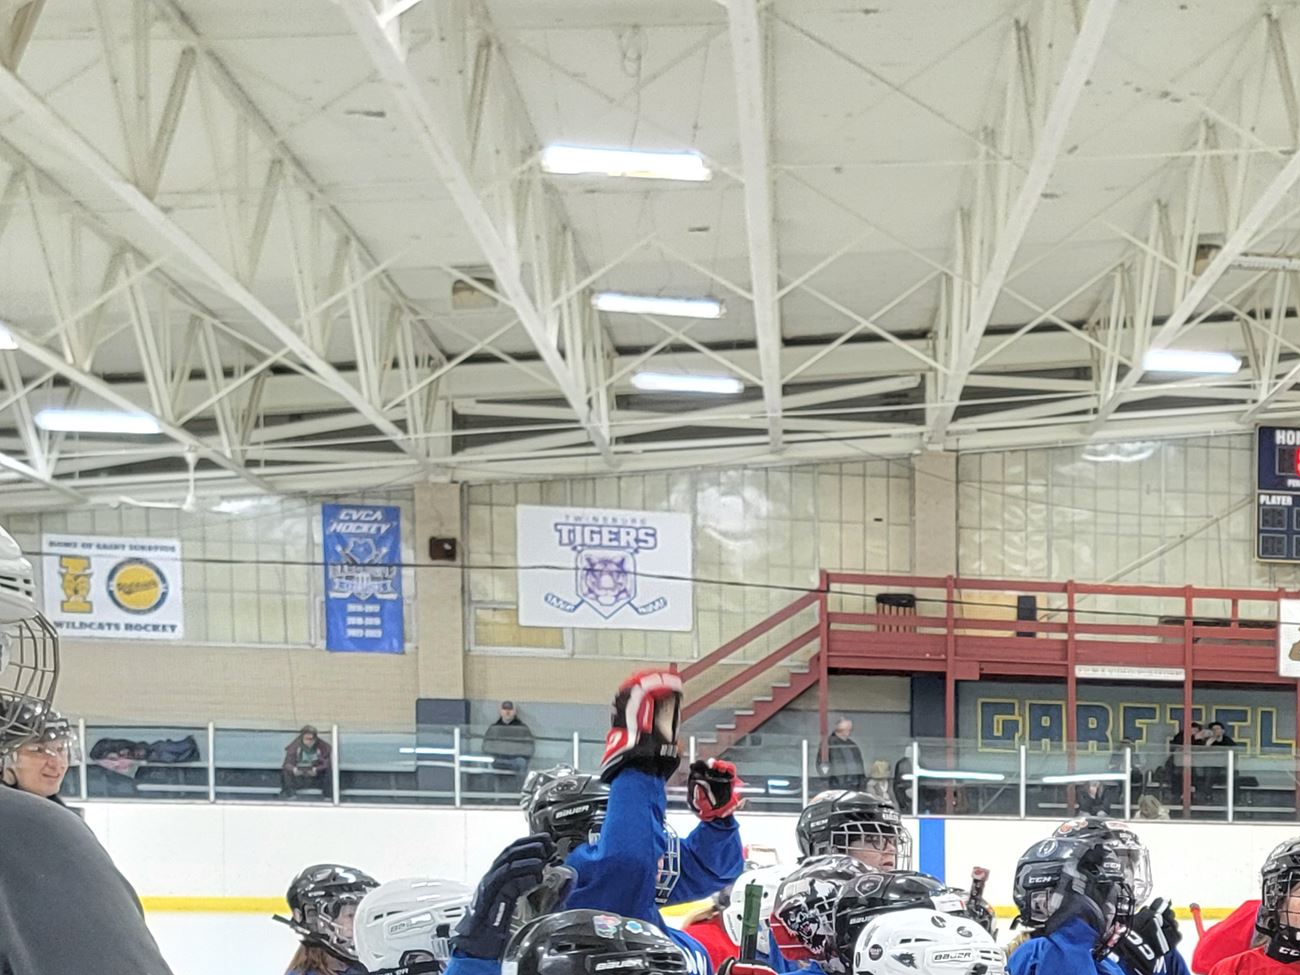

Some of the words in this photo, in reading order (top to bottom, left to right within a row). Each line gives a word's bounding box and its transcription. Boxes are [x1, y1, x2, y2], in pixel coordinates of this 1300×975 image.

[1259, 494, 1293, 507] PLAYER
[339, 508, 383, 521] CVCA
[330, 521, 392, 535] HOCKEY
[554, 523, 657, 550] TIGERS
[53, 620, 120, 632] WILDCATS
[124, 622, 178, 634] HOCKEY
[555, 804, 590, 819] BAUER
[1028, 875, 1052, 884] CCM
[933, 951, 972, 962] BAUER
[595, 958, 646, 971] BAUER
